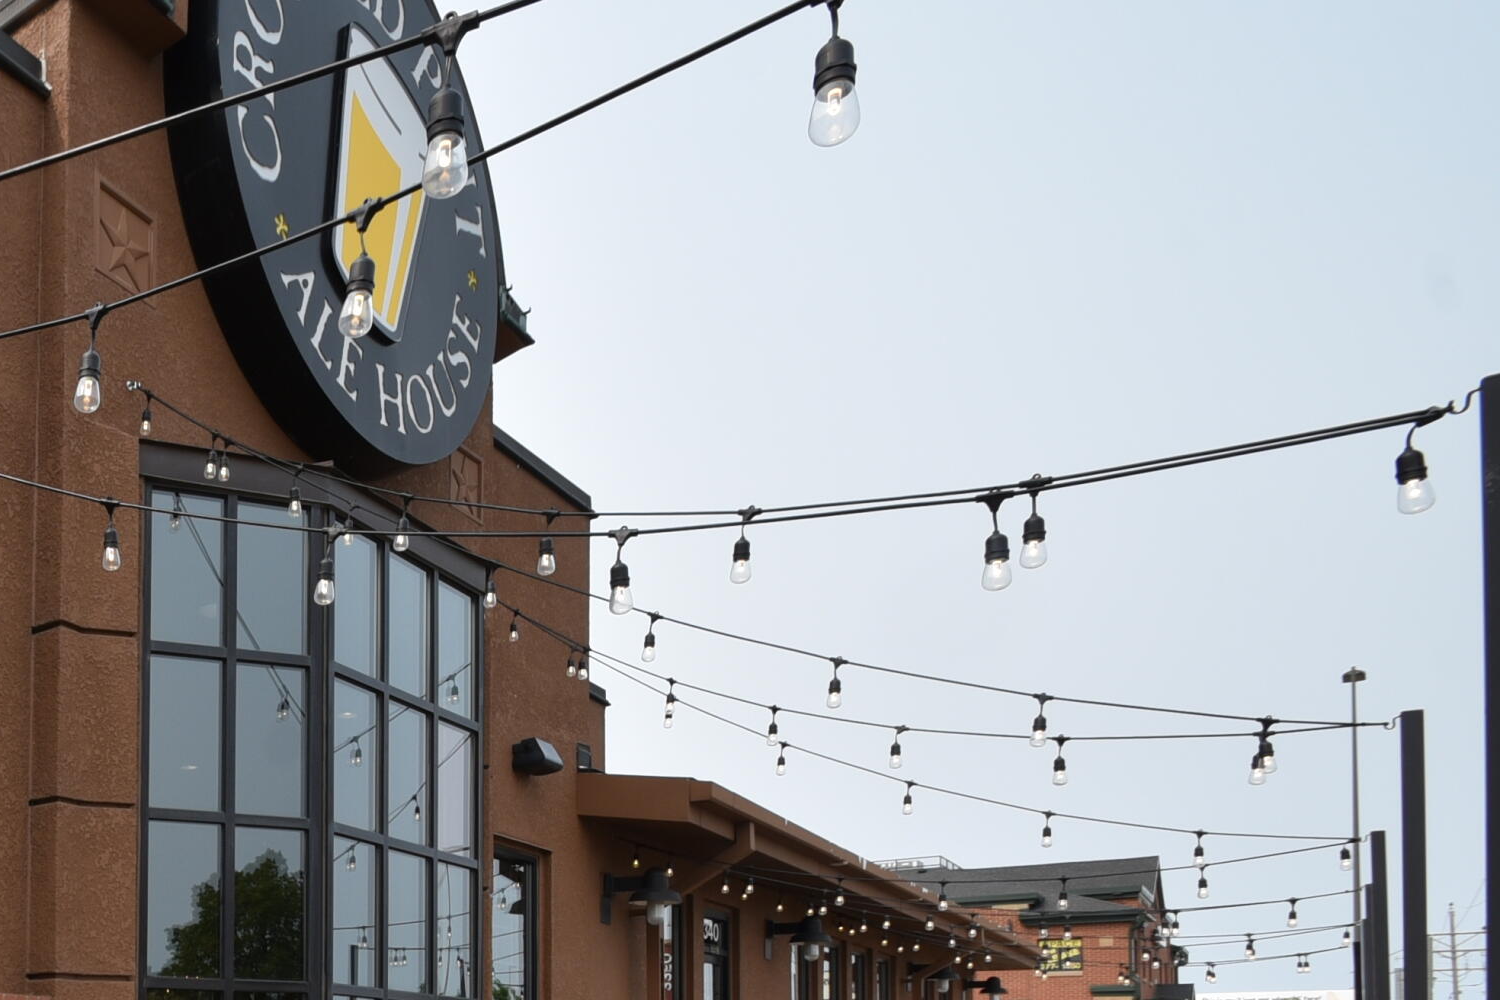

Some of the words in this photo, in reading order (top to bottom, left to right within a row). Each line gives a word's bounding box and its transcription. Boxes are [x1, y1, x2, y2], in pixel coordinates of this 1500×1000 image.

[280, 271, 363, 402] ALE
[375, 294, 481, 435] HOUSE
[703, 922, 719, 942] 340
